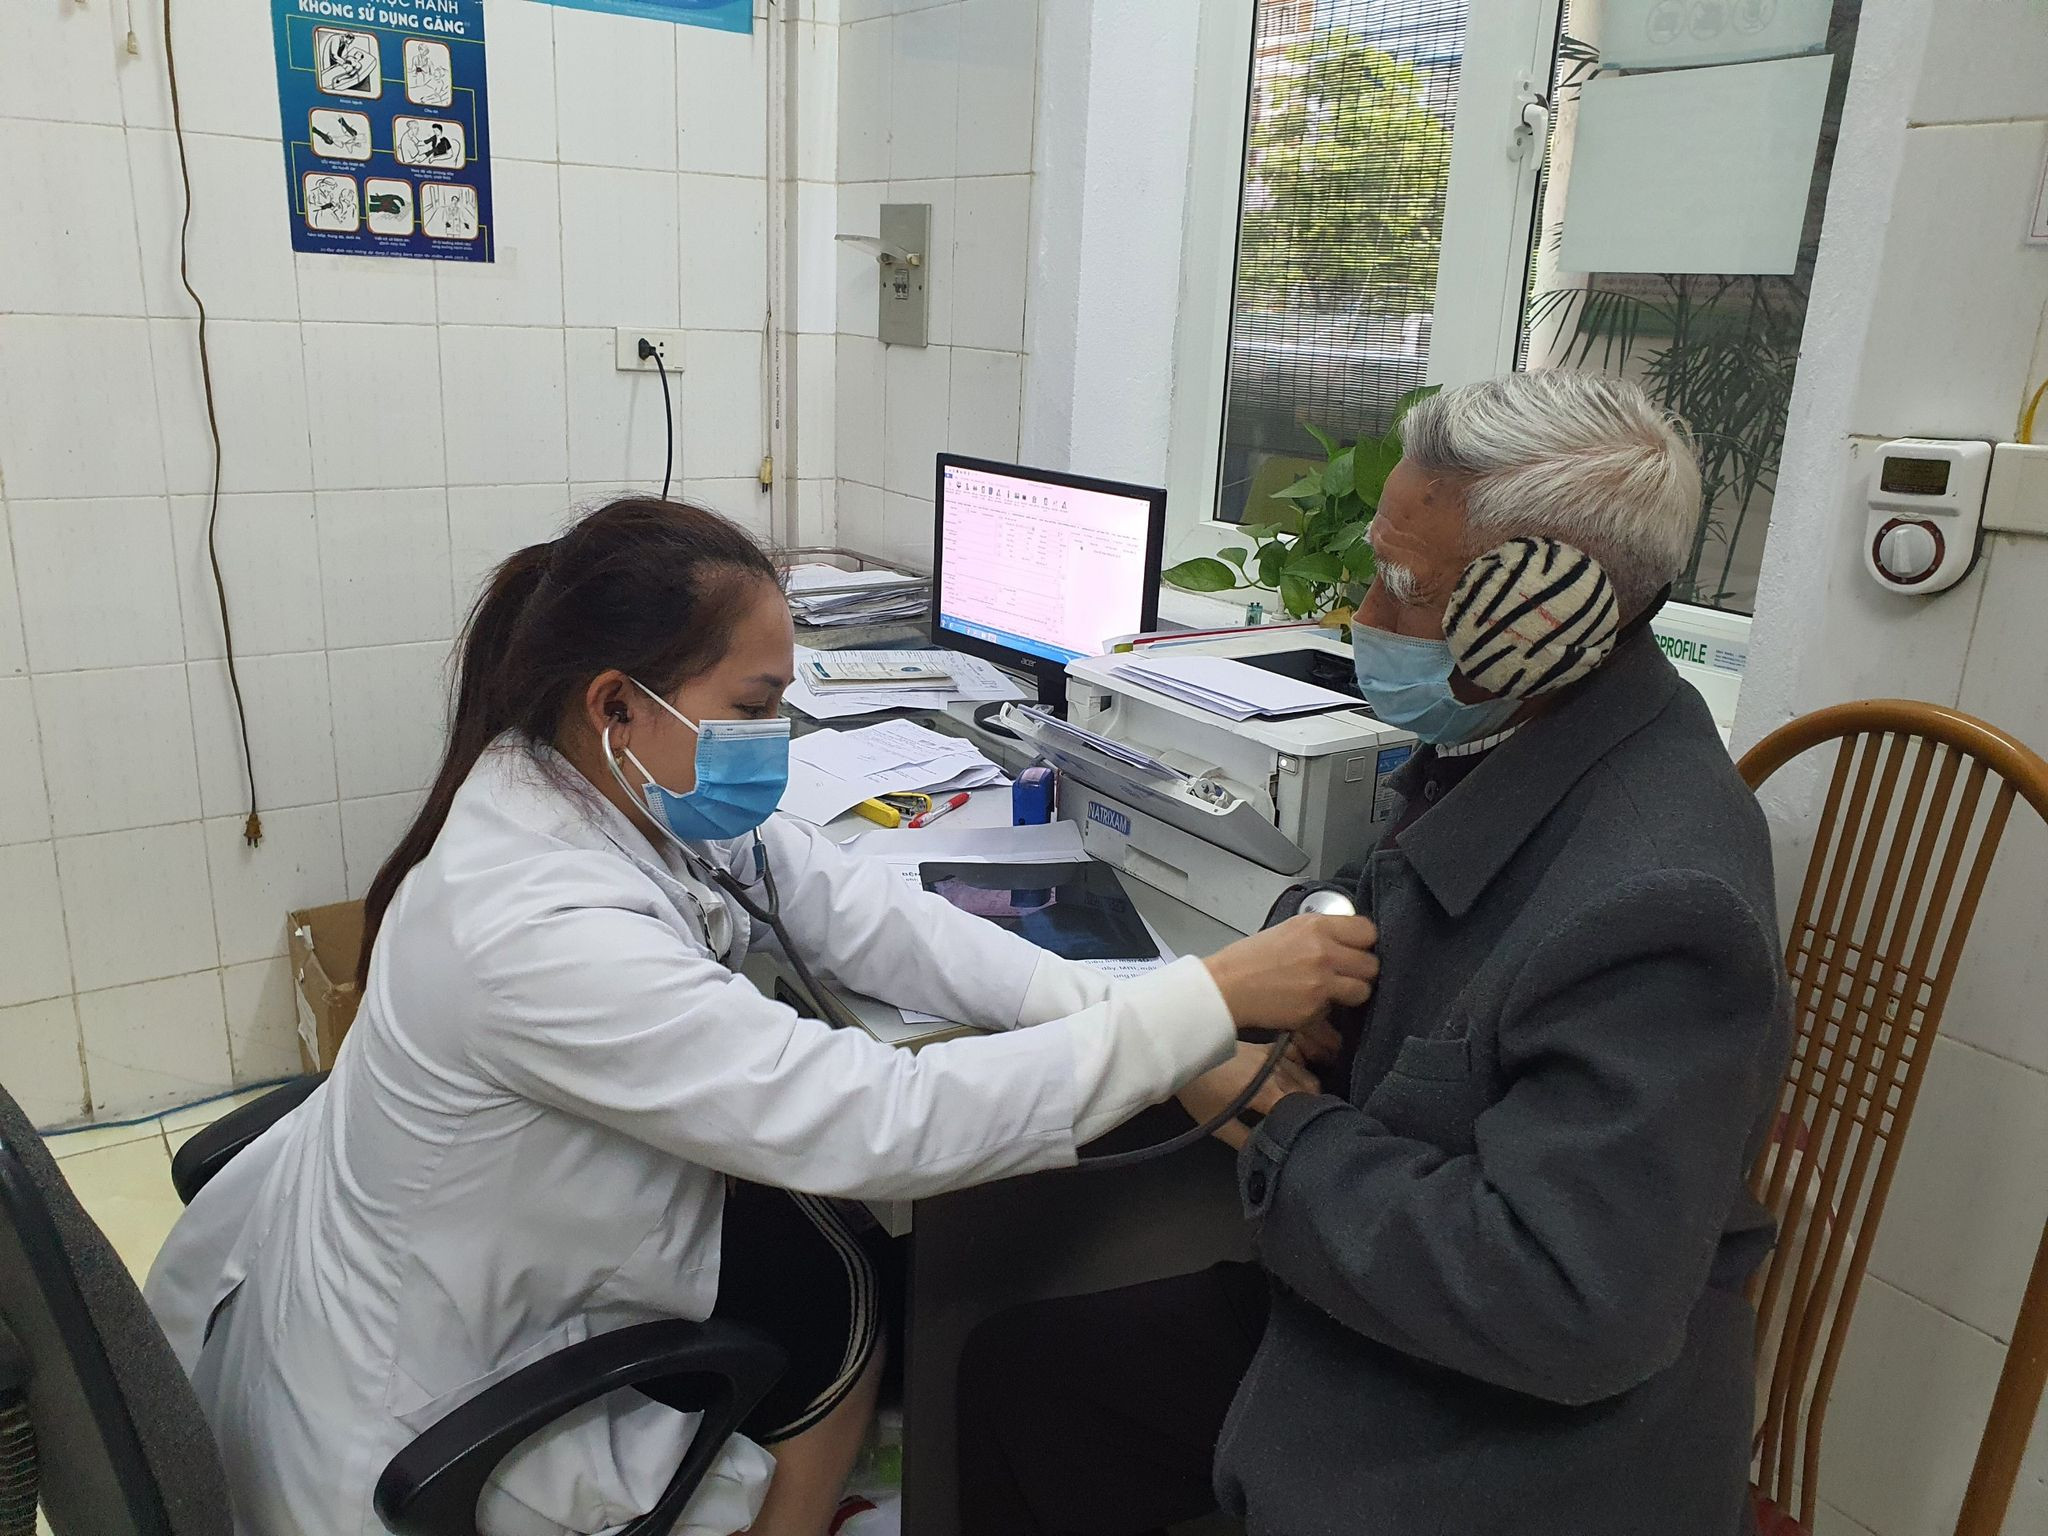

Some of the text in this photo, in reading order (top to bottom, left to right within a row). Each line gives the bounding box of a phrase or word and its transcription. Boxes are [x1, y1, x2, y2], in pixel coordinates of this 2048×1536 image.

[379, 10, 419, 28] DỤNG
[423, 14, 465, 34] GĂNG
[1089, 802, 1128, 833] NATRIXAM
